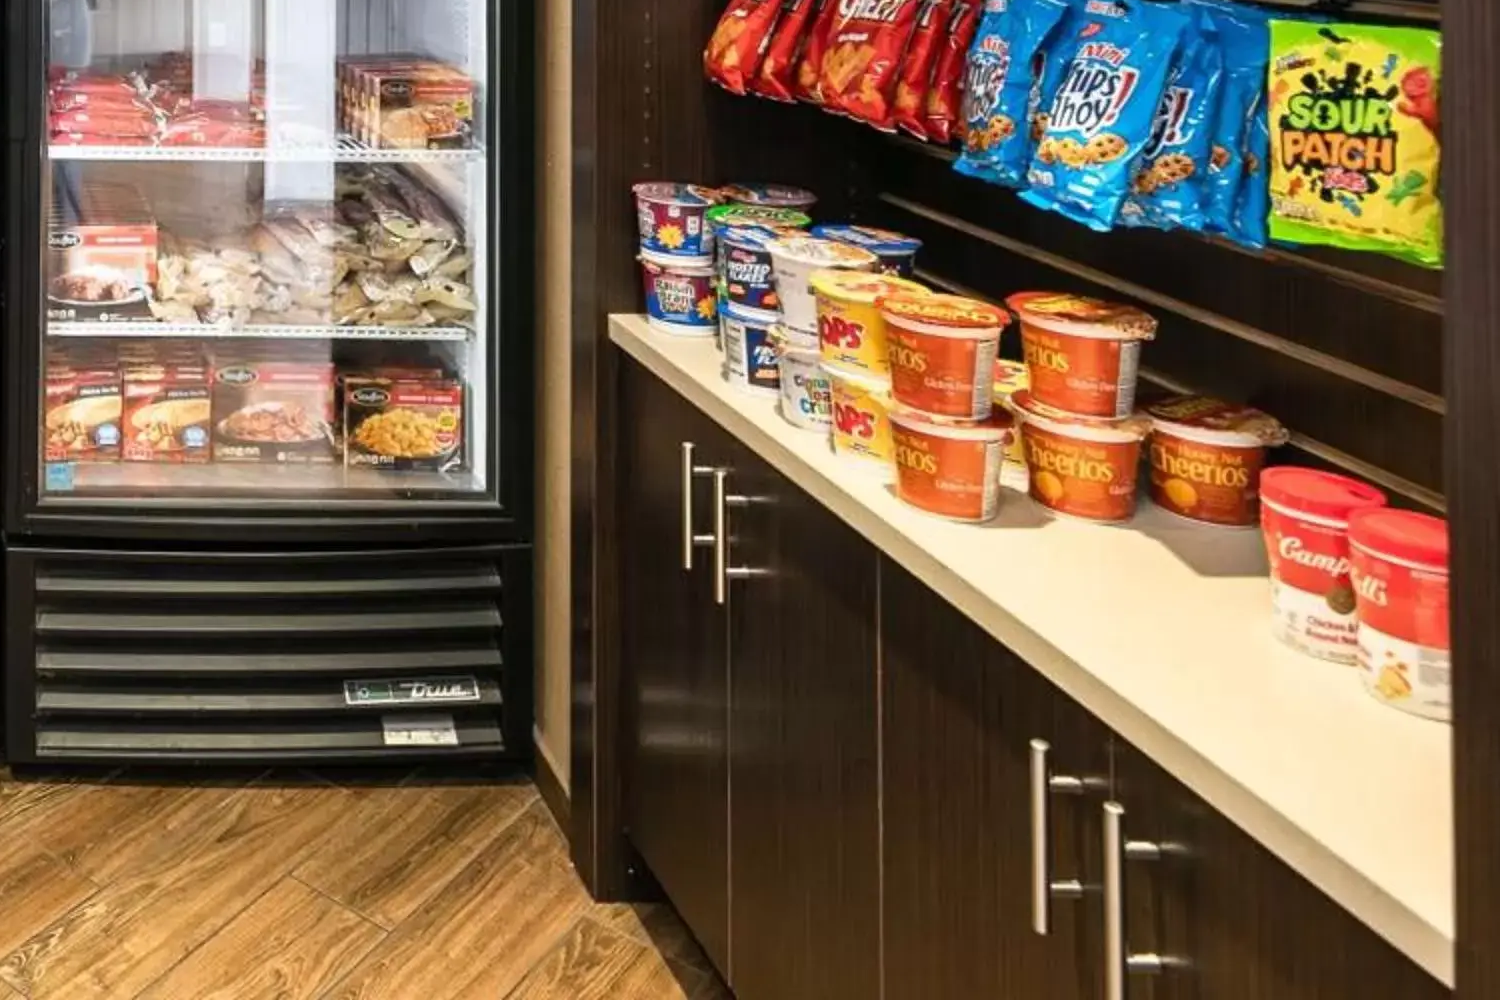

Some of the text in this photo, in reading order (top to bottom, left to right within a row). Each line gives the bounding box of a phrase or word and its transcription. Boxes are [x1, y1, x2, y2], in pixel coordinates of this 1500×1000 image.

[1287, 92, 1392, 136] SOUR
[1281, 130, 1397, 175] PATCH
[1151, 444, 1249, 488] Cheerios
